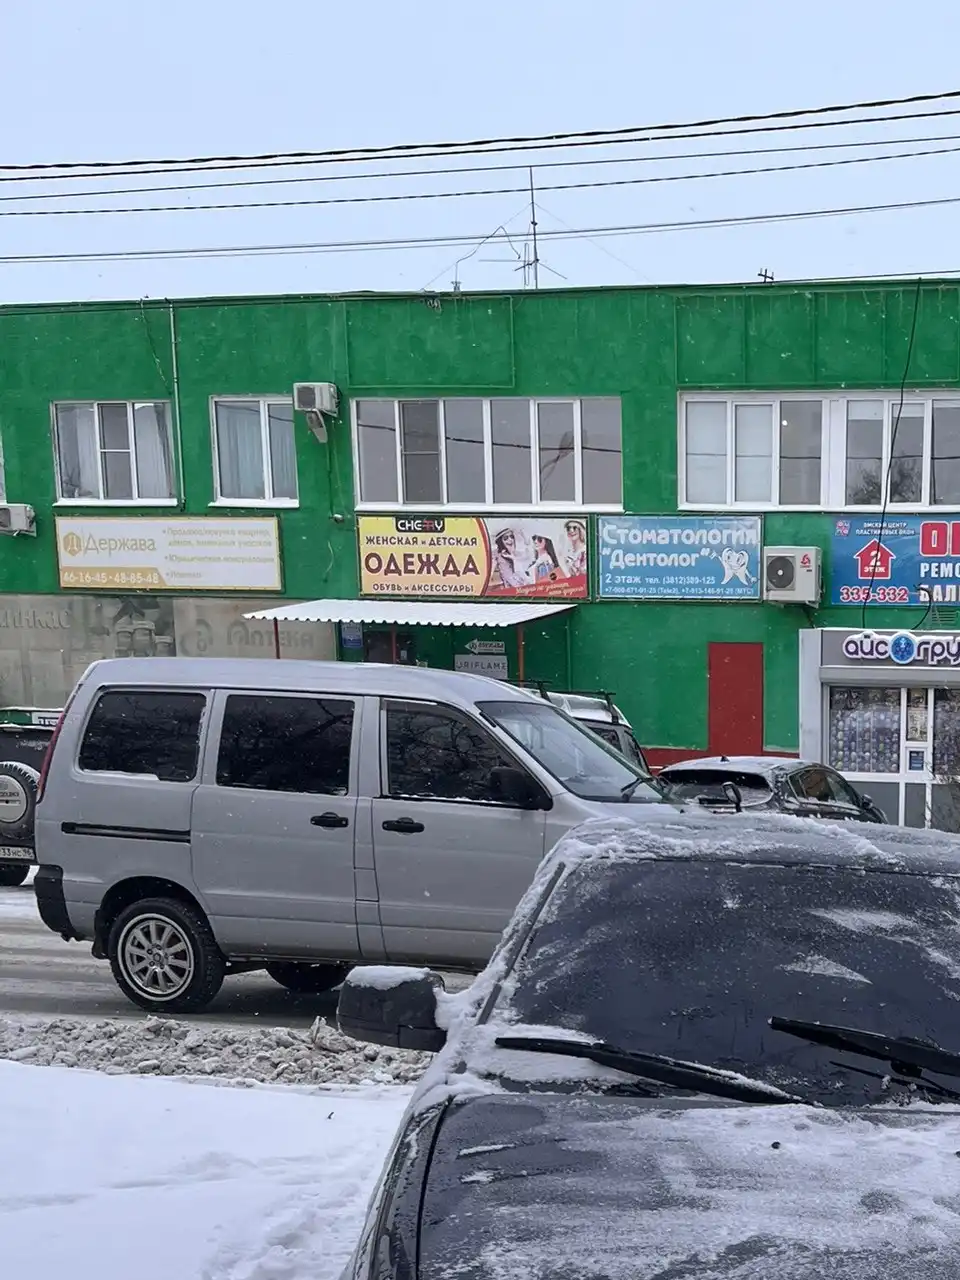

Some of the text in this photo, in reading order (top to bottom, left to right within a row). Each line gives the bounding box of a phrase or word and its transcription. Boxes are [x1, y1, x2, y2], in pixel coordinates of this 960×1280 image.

[602, 523, 758, 545] Стоматология
[84, 533, 156, 557] Держава
[365, 536, 418, 546] ЖЕНСКАЯ
[428, 536, 477, 547] ДЕТСКАЯ
[364, 552, 480, 576] ОДЕЖДА
[870, 550, 881, 566] 2
[63, 571, 107, 583] 46-16-45
[114, 572, 160, 584] 48-85-48
[605, 574, 612, 583] 2
[615, 576, 641, 584] этаж
[373, 583, 402, 592] ОБУВЬ
[411, 583, 474, 593] АКСЕССУАРЫ
[840, 586, 908, 603] 335-332
[456, 660, 507, 671] ORIFLAME
